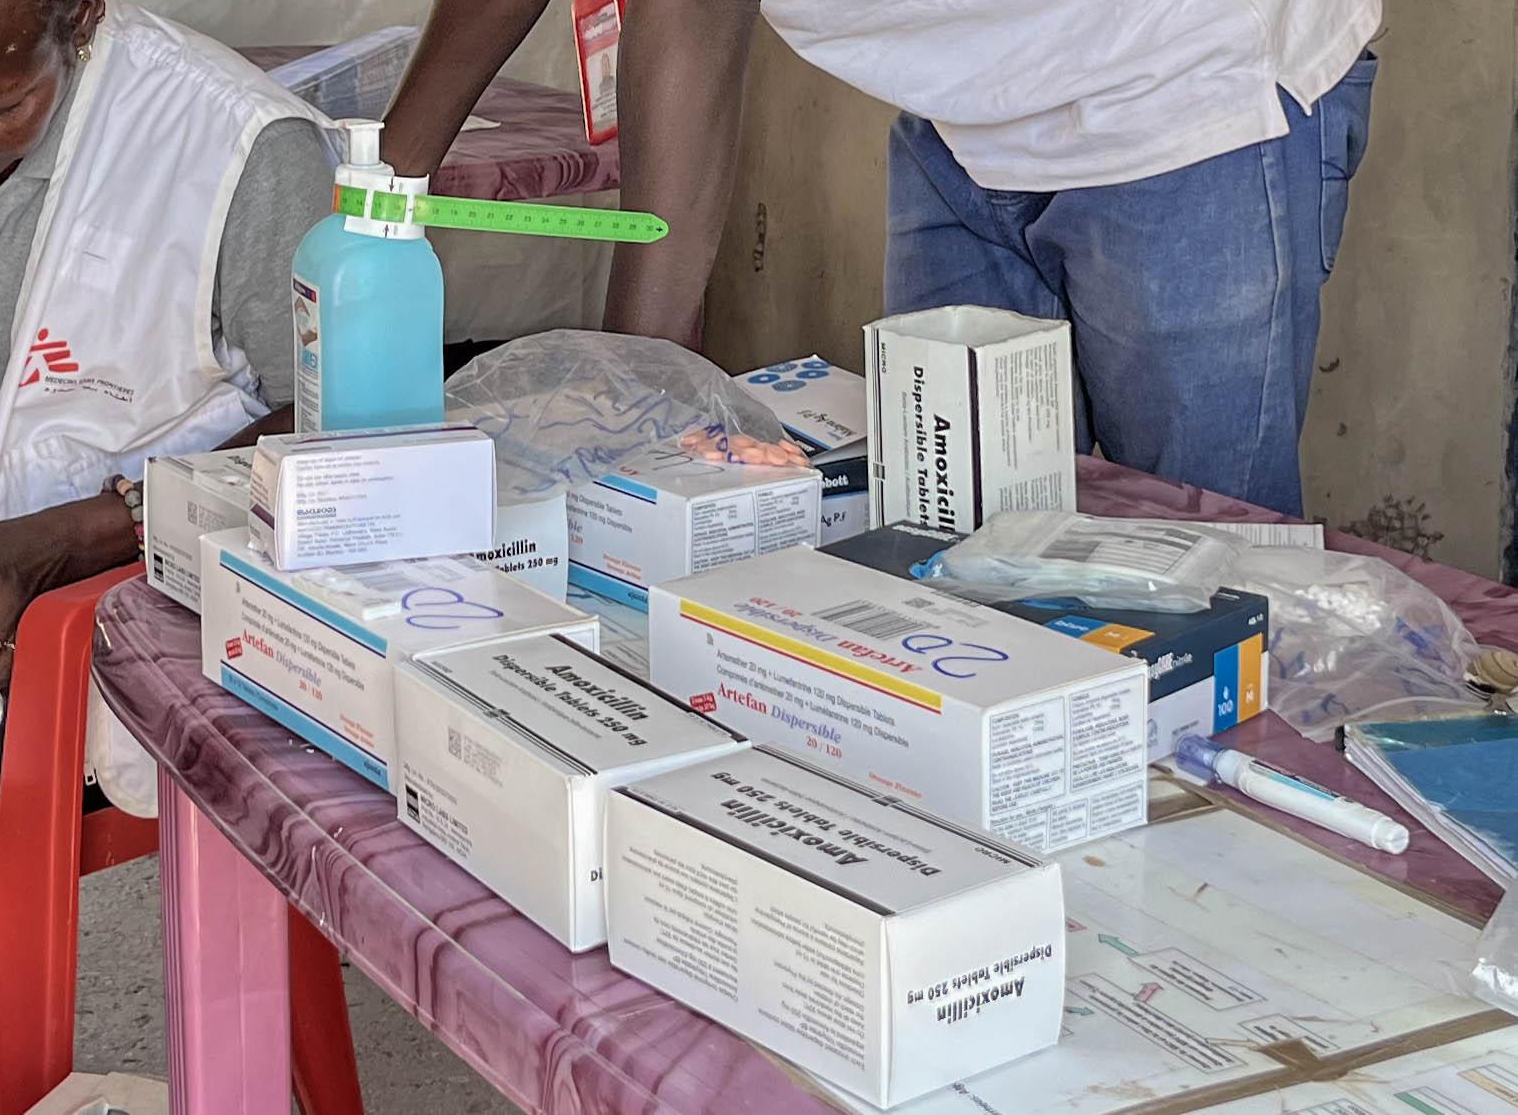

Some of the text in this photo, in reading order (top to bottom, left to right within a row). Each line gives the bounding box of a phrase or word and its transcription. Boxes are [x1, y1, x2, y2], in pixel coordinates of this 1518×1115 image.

[911, 366, 928, 462] Dispersible
[933, 413, 956, 533] Amoxicill
[472, 539, 537, 561] moxicillin
[528, 557, 543, 569] 250
[545, 556, 558, 566] mg
[242, 629, 274, 658] Artefan
[837, 639, 922, 674] Artefan
[492, 653, 647, 747] Dispersible Tablets 250 mg
[545, 663, 649, 721] Amoxicillin
[717, 681, 767, 715] Artefan
[771, 702, 840, 748] Dispersible
[1217, 699, 1233, 717] 100
[806, 735, 817, 750] 20
[825, 742, 842, 760] 120
[711, 771, 942, 877] Dispersible Tablets 250 mg
[720, 797, 869, 866] Amoxicillin
[907, 943, 1052, 1005] Dispersible Tablets 250 mg
[936, 976, 1025, 1025] Amoxicillin
